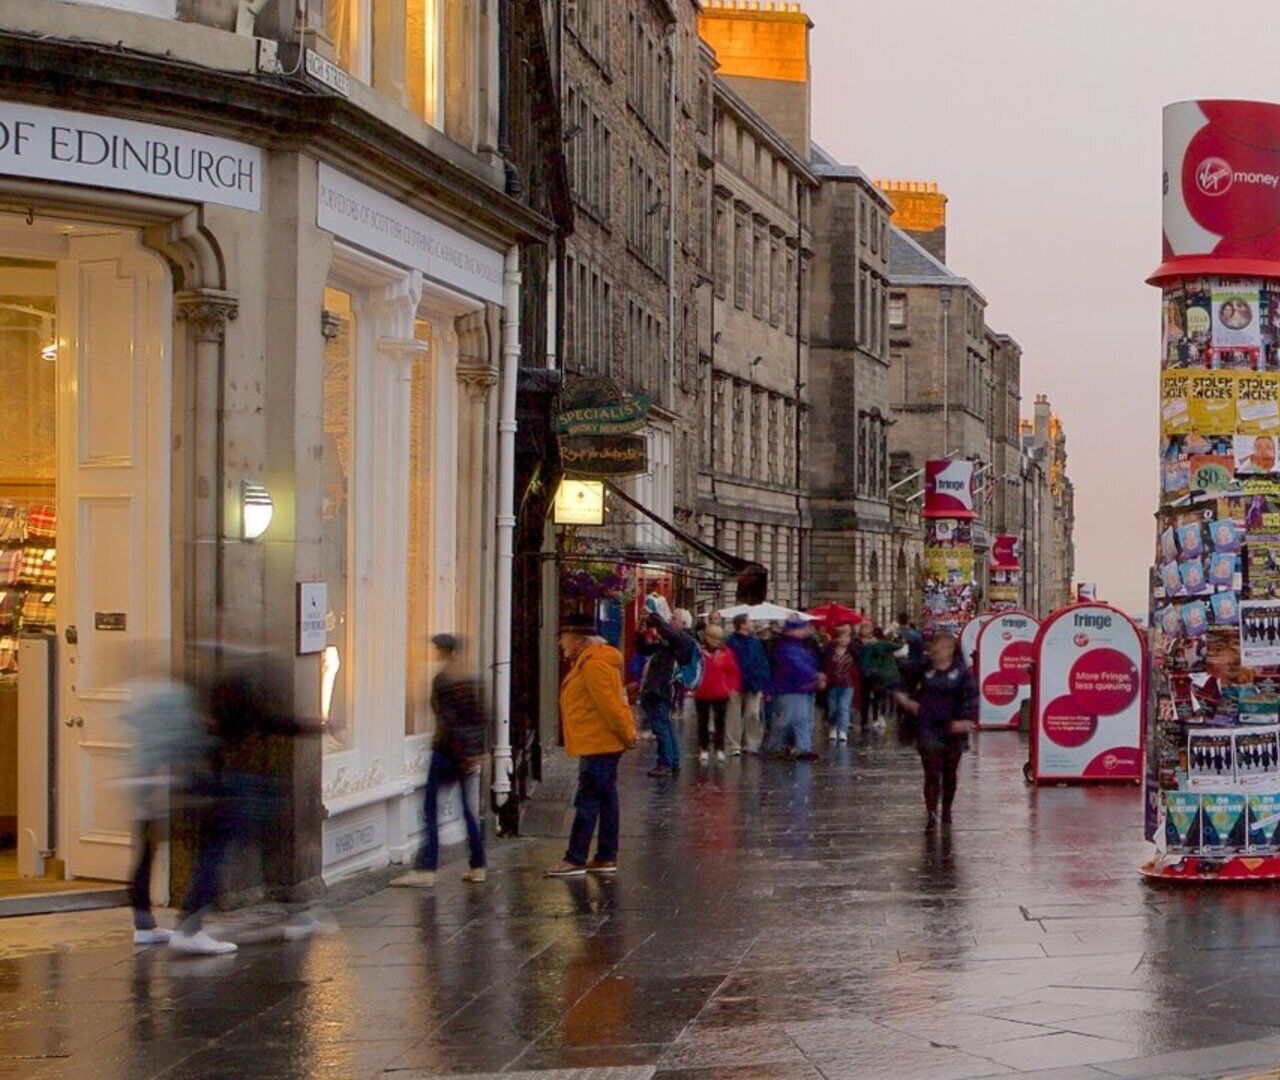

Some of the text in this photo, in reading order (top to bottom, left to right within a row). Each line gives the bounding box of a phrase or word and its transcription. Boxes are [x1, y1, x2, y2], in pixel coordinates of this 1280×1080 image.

[51, 126, 254, 193] EDINBURGH
[1234, 171, 1279, 188] money
[558, 398, 643, 425] SPECIALIST
[1196, 469, 1219, 488] 80
[1074, 613, 1112, 630] fringe
[1075, 672, 1100, 680] More
[1074, 682, 1132, 692] less queuing
